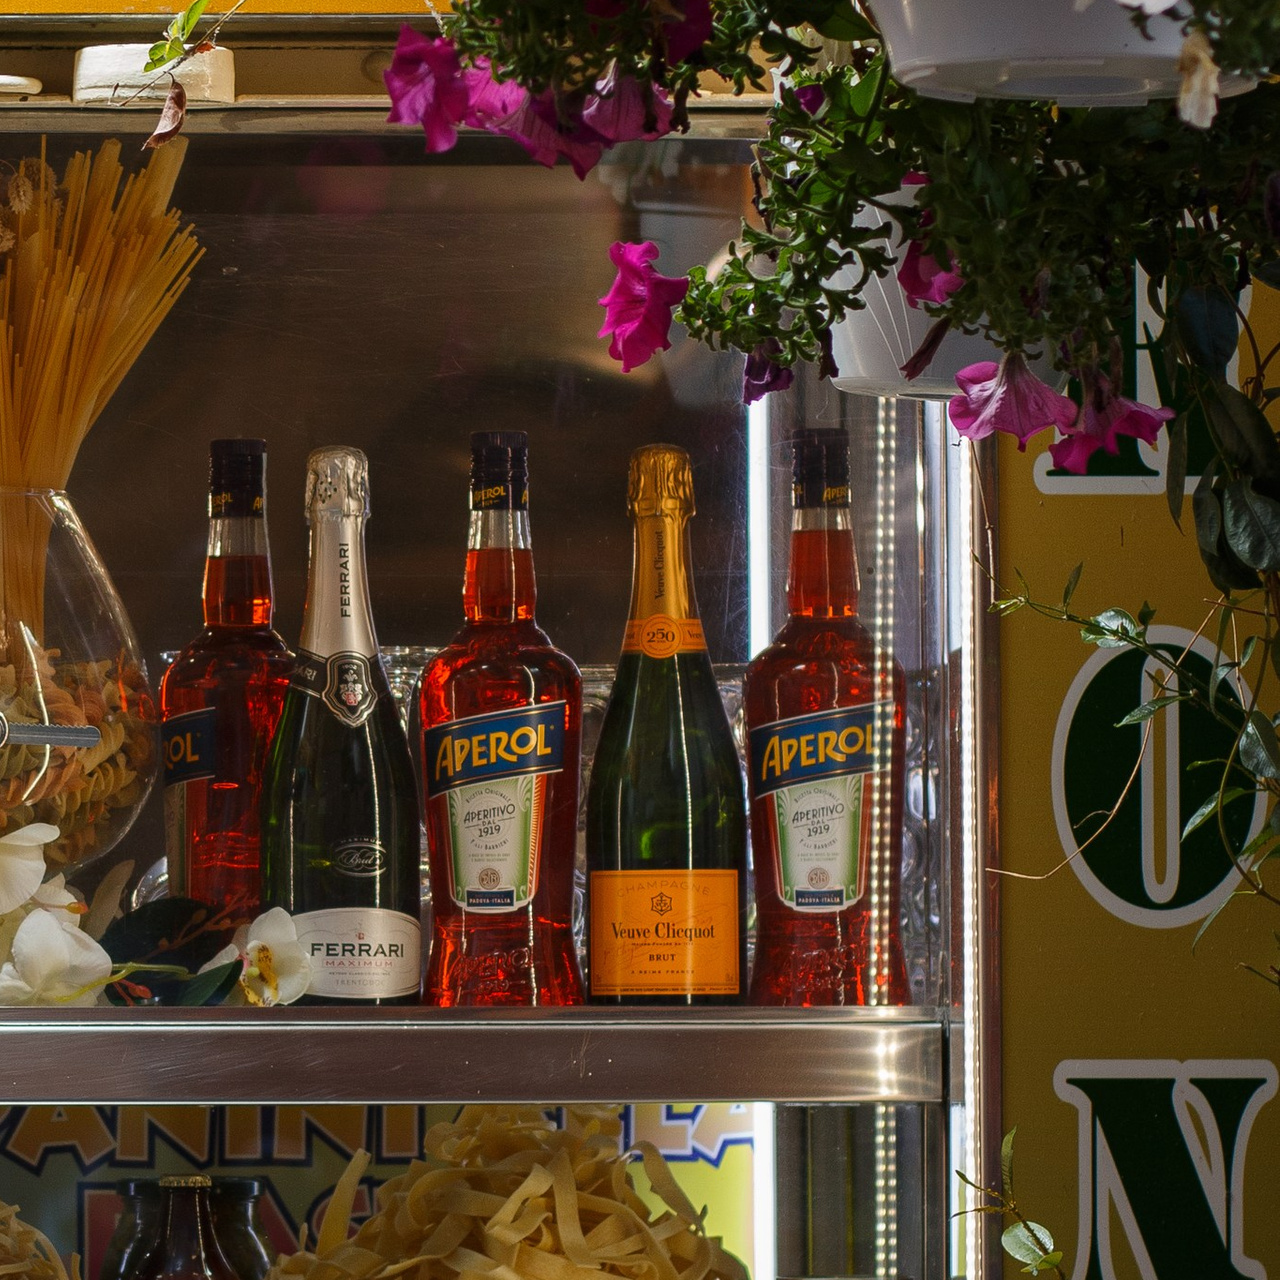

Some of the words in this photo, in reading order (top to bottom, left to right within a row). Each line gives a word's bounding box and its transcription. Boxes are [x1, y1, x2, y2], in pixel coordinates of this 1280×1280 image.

[654, 530, 666, 571] Clicquot
[338, 542, 352, 618] FERRARI
[654, 573, 666, 601] Veuve
[646, 628, 676, 644] 250
[435, 723, 552, 782] APEROL
[761, 723, 878, 783] APEROL
[463, 803, 516, 826] APERITIVO
[791, 803, 845, 824] APERITIVO
[478, 824, 501, 838] 1919
[481, 819, 497, 827] DAL
[807, 823, 831, 838] 1919
[810, 819, 826, 827] DAL
[616, 880, 712, 898] CHAMPAGNE
[611, 921, 651, 940] Veuve
[654, 921, 716, 942] Clicquot
[310, 942, 405, 958] FERRARI
[648, 953, 677, 962] BRUT
[324, 960, 394, 968] MAXIMUM
